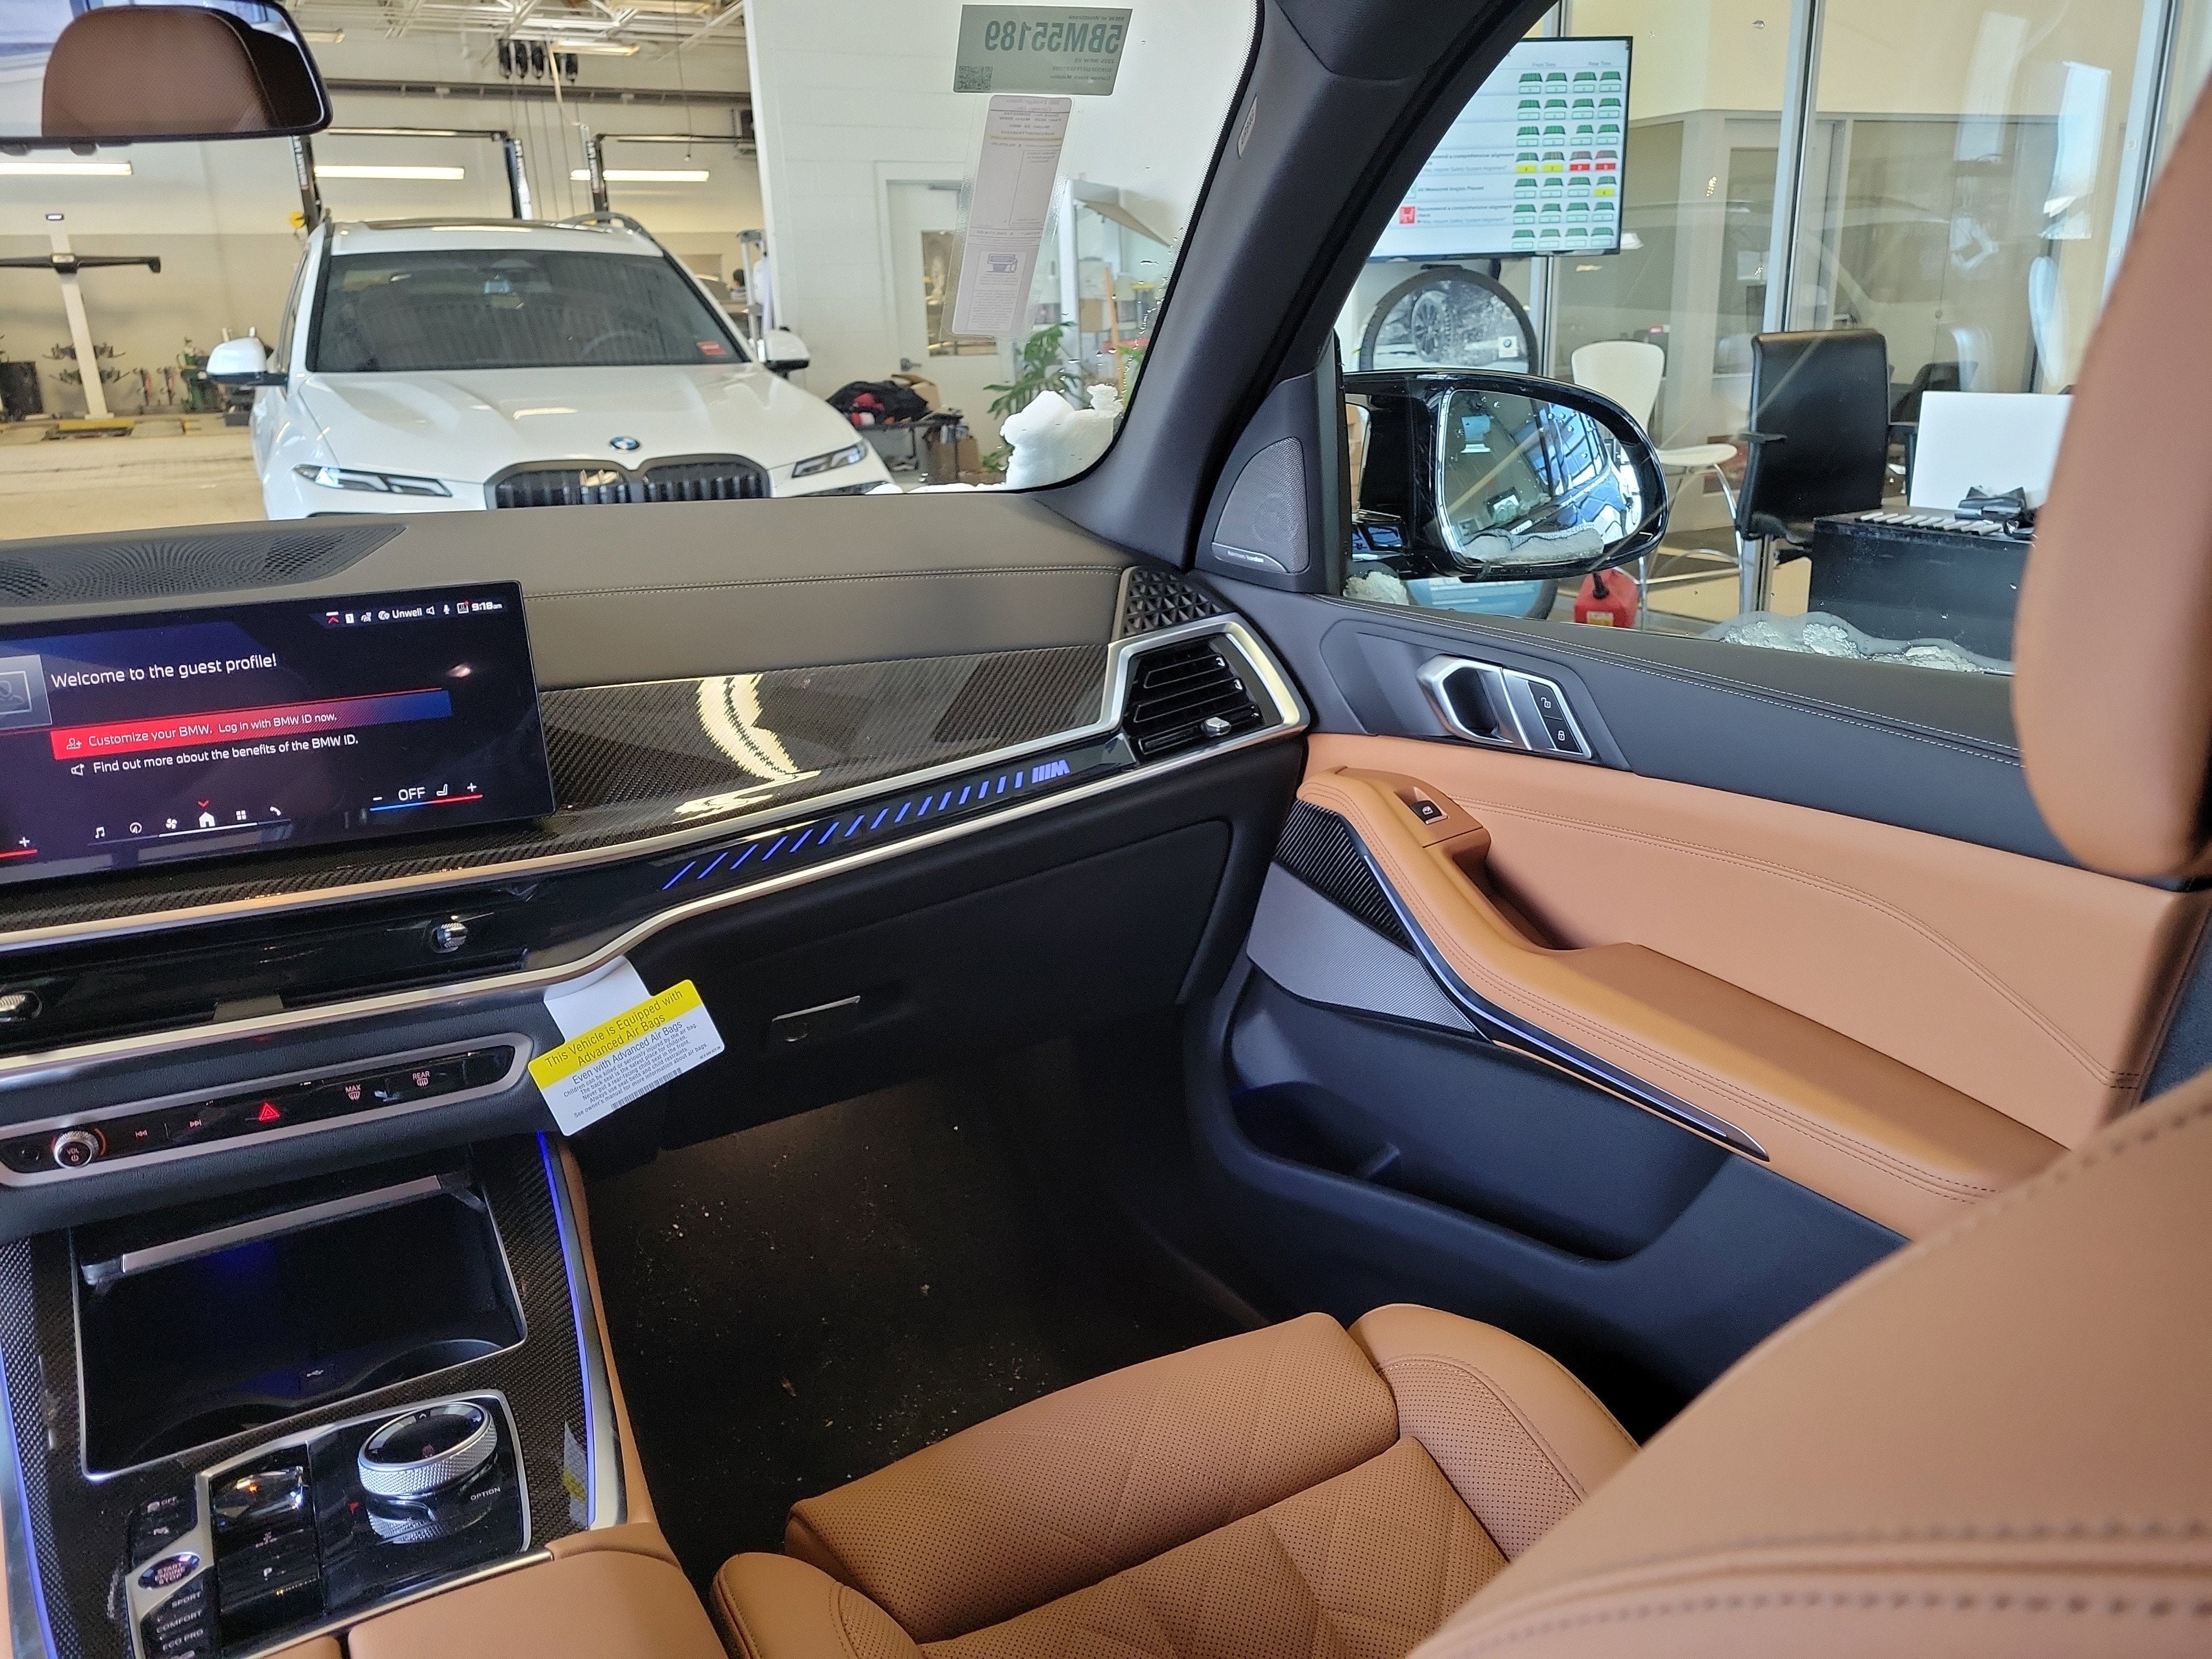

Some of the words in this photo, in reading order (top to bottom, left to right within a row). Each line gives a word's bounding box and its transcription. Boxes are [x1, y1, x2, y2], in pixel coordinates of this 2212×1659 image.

[392, 607, 422, 619] Unwell
[51, 668, 125, 688] Welcome
[129, 668, 145, 681] to
[148, 664, 174, 679] the
[178, 659, 223, 679] guest
[225, 653, 278, 674] profile!
[88, 732, 149, 747] Customize
[151, 729, 176, 744] your
[179, 723, 212, 737] BMW.
[218, 723, 238, 733] Log
[240, 721, 249, 730] in
[251, 719, 272, 730] with
[273, 715, 300, 727] BMW
[301, 714, 313, 724] ID
[314, 713, 337, 723] now.
[93, 758, 119, 774] Find
[122, 758, 142, 770] out
[144, 756, 174, 768] more
[176, 752, 210, 764] about
[211, 748, 230, 760] the
[232, 743, 276, 758] benefits
[278, 741, 290, 753] of
[291, 740, 309, 752] the
[311, 735, 342, 749] BMW
[343, 733, 358, 746] ID.
[398, 786, 425, 801] OFF
[544, 1052, 568, 1067] This
[568, 1032, 605, 1054] Vehicle
[605, 1026, 616, 1036] is
[616, 1000, 661, 1030] Equipped
[661, 990, 682, 1006] with
[578, 1034, 624, 1066] Advanced
[626, 1027, 639, 1041] Air
[640, 1014, 665, 1031] Bags
[563, 1084, 585, 1097] Children
[602, 1065, 617, 1076] killed
[623, 1051, 646, 1065] seriously
[646, 1040, 663, 1053] injured
[670, 1031, 679, 1040] the
[572, 1070, 593, 1084] Even
[593, 1059, 611, 1073] with
[612, 1037, 650, 1063] Advanced
[651, 1031, 661, 1043] Air
[662, 1022, 682, 1036] Bags
[582, 1090, 597, 1100] Never
[597, 1084, 607, 1093] put
[611, 1068, 638, 1085] rear-facing
[639, 1060, 651, 1070] child
[651, 1054, 662, 1063] seat
[676, 1040, 690, 1049] front.
[590, 1080, 603, 1090] back
[603, 1074, 614, 1082] seat
[629, 1057, 644, 1068] safest
[645, 1051, 658, 1061] place
[666, 1035, 687, 1048] children.
[345, 1084, 360, 1093] MAX
[413, 1071, 430, 1080] REAR
[584, 1099, 604, 1112] owner's
[605, 1088, 623, 1101] manual
[631, 1077, 645, 1087] more
[645, 1062, 673, 1079] information
[673, 1053, 687, 1064] about
[694, 1043, 707, 1052] bags.
[590, 1091, 607, 1103] Always
[618, 1079, 629, 1087] seat
[628, 1073, 641, 1081] belts
[642, 1066, 651, 1075] and
[652, 1059, 664, 1069] child
[664, 1047, 687, 1062] restraints.
[470, 1487, 500, 1501] OPTION
[172, 1591, 202, 1609] SPORT
[156, 1609, 203, 1634] COMFORT
[162, 1637, 182, 1651] ECO
[184, 1628, 204, 1642] PRO
